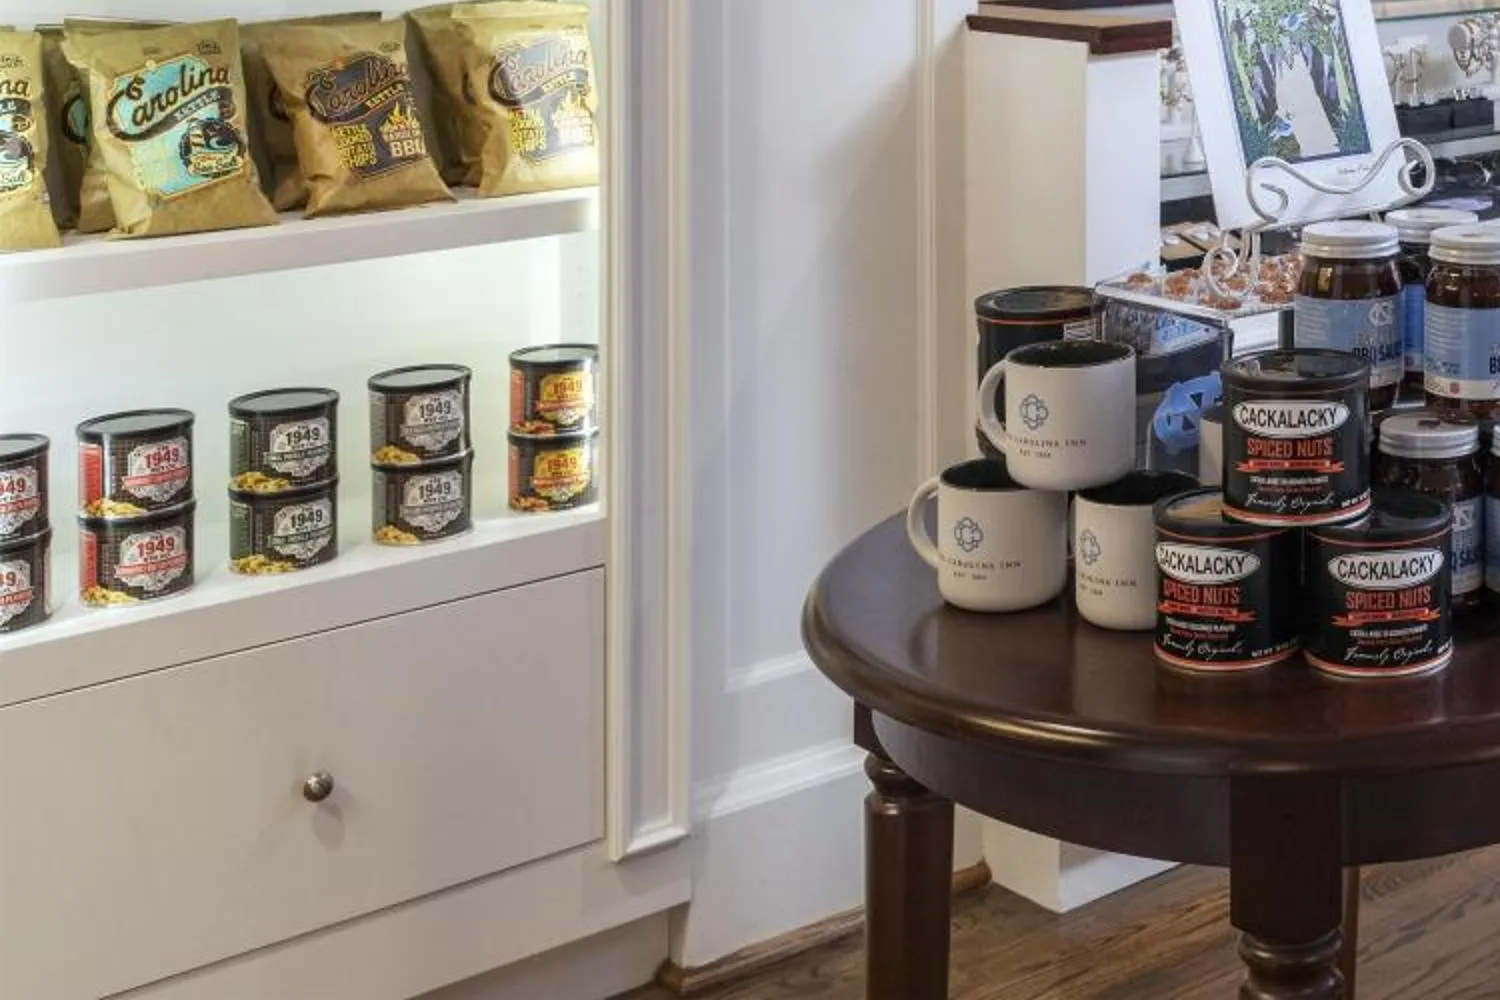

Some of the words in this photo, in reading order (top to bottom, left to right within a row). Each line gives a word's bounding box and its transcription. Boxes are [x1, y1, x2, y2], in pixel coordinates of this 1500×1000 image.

[106, 63, 231, 141] Carolina
[420, 400, 450, 418] 1949
[1240, 405, 1337, 428] CACKALACKY
[286, 427, 320, 445] 1949
[145, 448, 179, 466] 1949
[1247, 439, 1292, 458] SPICED
[1297, 440, 1333, 457] NUTS
[419, 481, 450, 499] 1949
[291, 509, 323, 529] 1949
[137, 536, 175, 557] 1949
[1159, 547, 1246, 576] CACKALACKY
[1338, 553, 1436, 580] CACKALACKY
[1163, 579, 1199, 603] SPICED
[1203, 586, 1240, 604] NUTS
[1345, 591, 1395, 609] SPICED
[1400, 586, 1433, 608] NUTS
